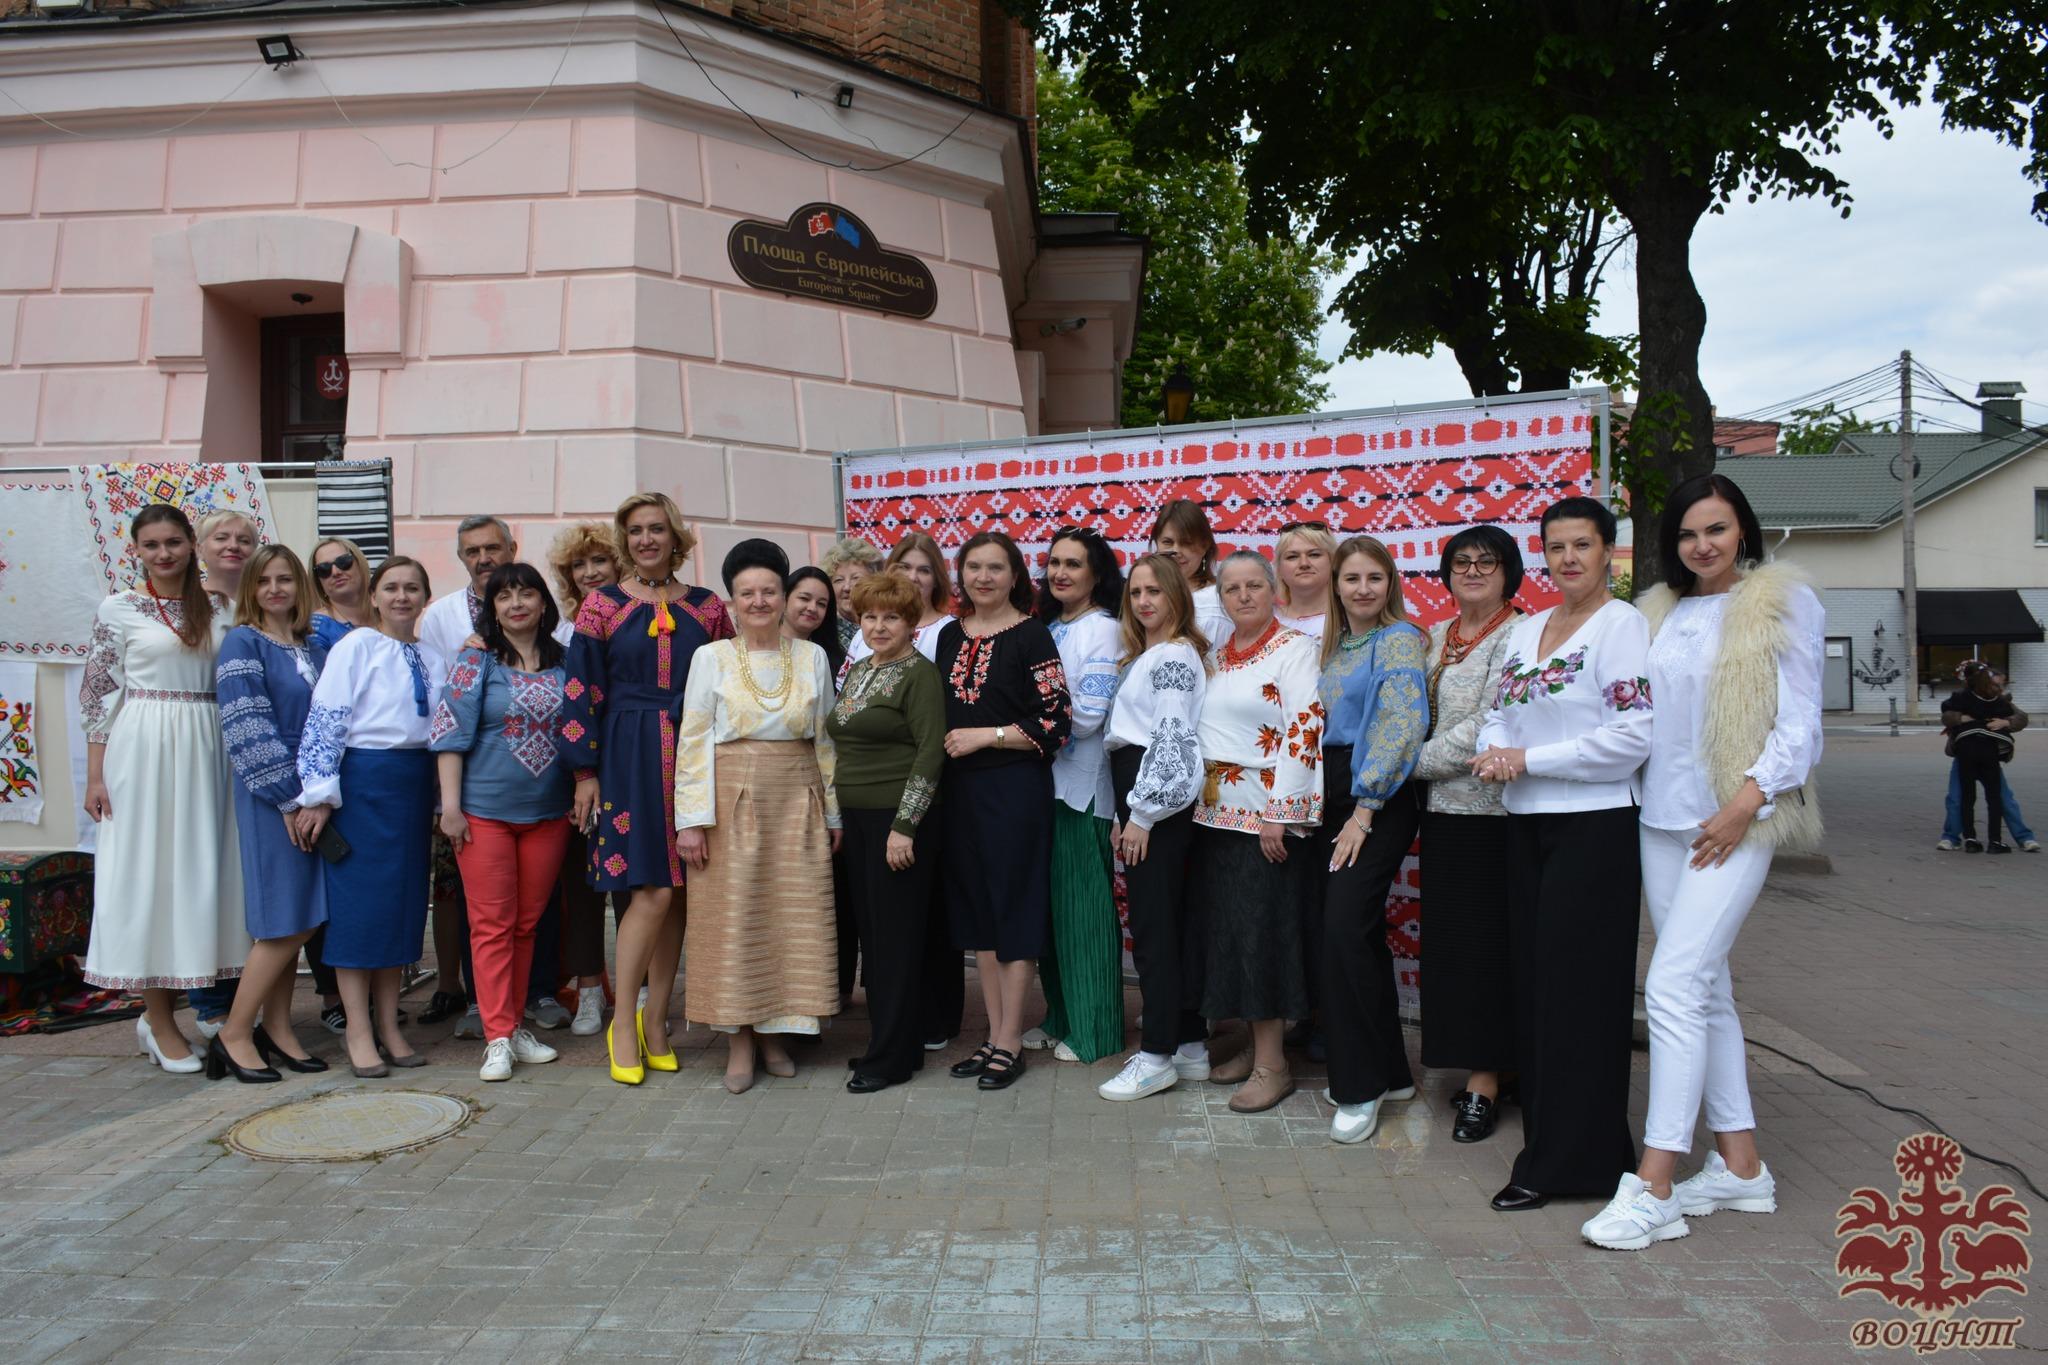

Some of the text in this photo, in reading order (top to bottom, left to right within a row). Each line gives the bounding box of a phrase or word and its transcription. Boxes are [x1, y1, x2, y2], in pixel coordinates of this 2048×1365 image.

[815, 251, 924, 289] Європейська
[798, 277, 881, 302] European Square
